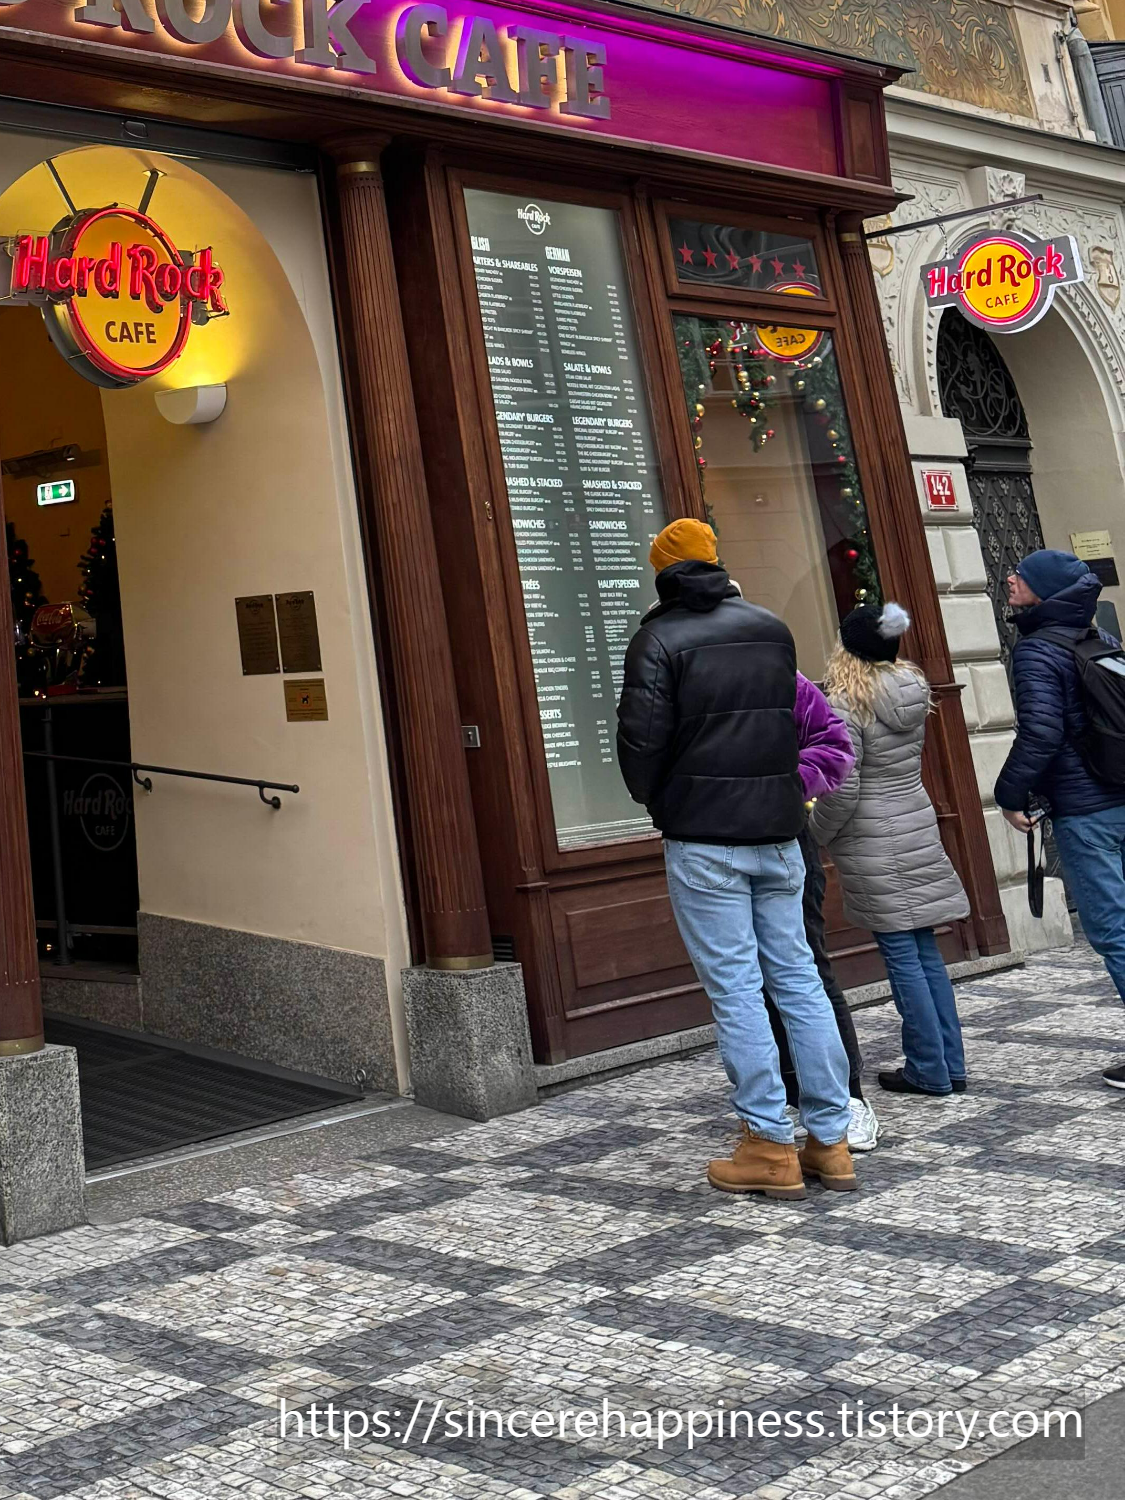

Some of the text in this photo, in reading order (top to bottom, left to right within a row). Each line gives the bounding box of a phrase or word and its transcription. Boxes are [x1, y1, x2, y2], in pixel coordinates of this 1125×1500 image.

[395, 3, 610, 121] CAFE
[517, 208, 551, 225] Hard Rock
[471, 236, 490, 251] GLISH
[473, 256, 494, 267] ARTERS
[502, 260, 538, 272] SHAREABLES
[13, 233, 228, 313] Hard Rock
[547, 265, 582, 277] VORSPEISEN
[927, 244, 1066, 298] Hard Rock
[985, 292, 1020, 309] CAFE
[105, 320, 157, 344] CAFE
[488, 356, 504, 365] LADS
[512, 357, 533, 368] BOWLS
[563, 363, 585, 373] SALATE
[591, 365, 612, 374] BOWLS
[527, 413, 554, 423] BURGERS
[607, 418, 633, 428] BURGERS
[537, 477, 563, 487] STACKED
[582, 480, 611, 489] SMASHED
[618, 481, 642, 490] STACKED
[931, 476, 951, 495] 142
[512, 519, 546, 529] NDWICHES
[589, 521, 627, 529] SANDWICHES
[521, 578, 540, 590] TRÉES
[598, 580, 640, 588] HAUPTSPEISEN
[539, 709, 562, 720] SSERTS
[63, 789, 132, 821] Hard Roc
